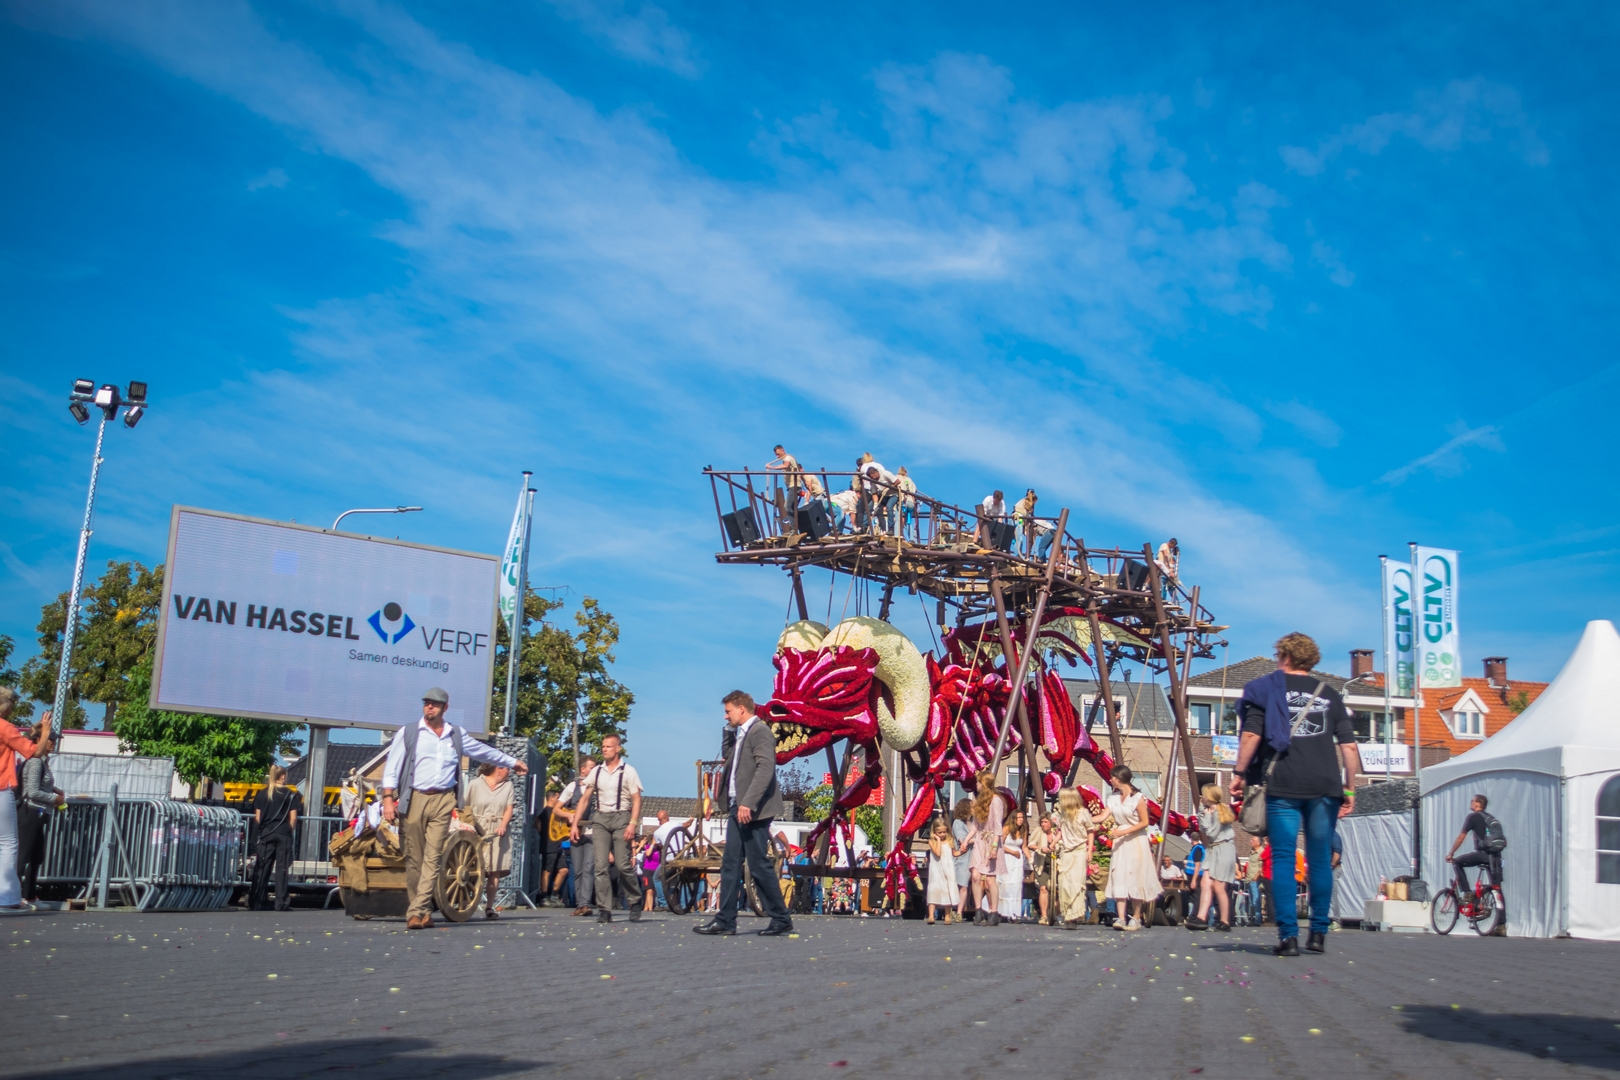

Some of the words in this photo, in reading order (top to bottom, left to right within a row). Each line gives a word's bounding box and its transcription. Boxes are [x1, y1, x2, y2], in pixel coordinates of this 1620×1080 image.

[174, 594, 237, 625] VAN
[246, 604, 360, 641] HASSEL
[421, 626, 488, 656] VERF
[1393, 583, 1412, 653] CLTV
[1424, 571, 1443, 644] CLTV
[349, 649, 388, 664] Samen
[391, 655, 449, 673] deskundig
[1361, 750, 1384, 758] VISIT
